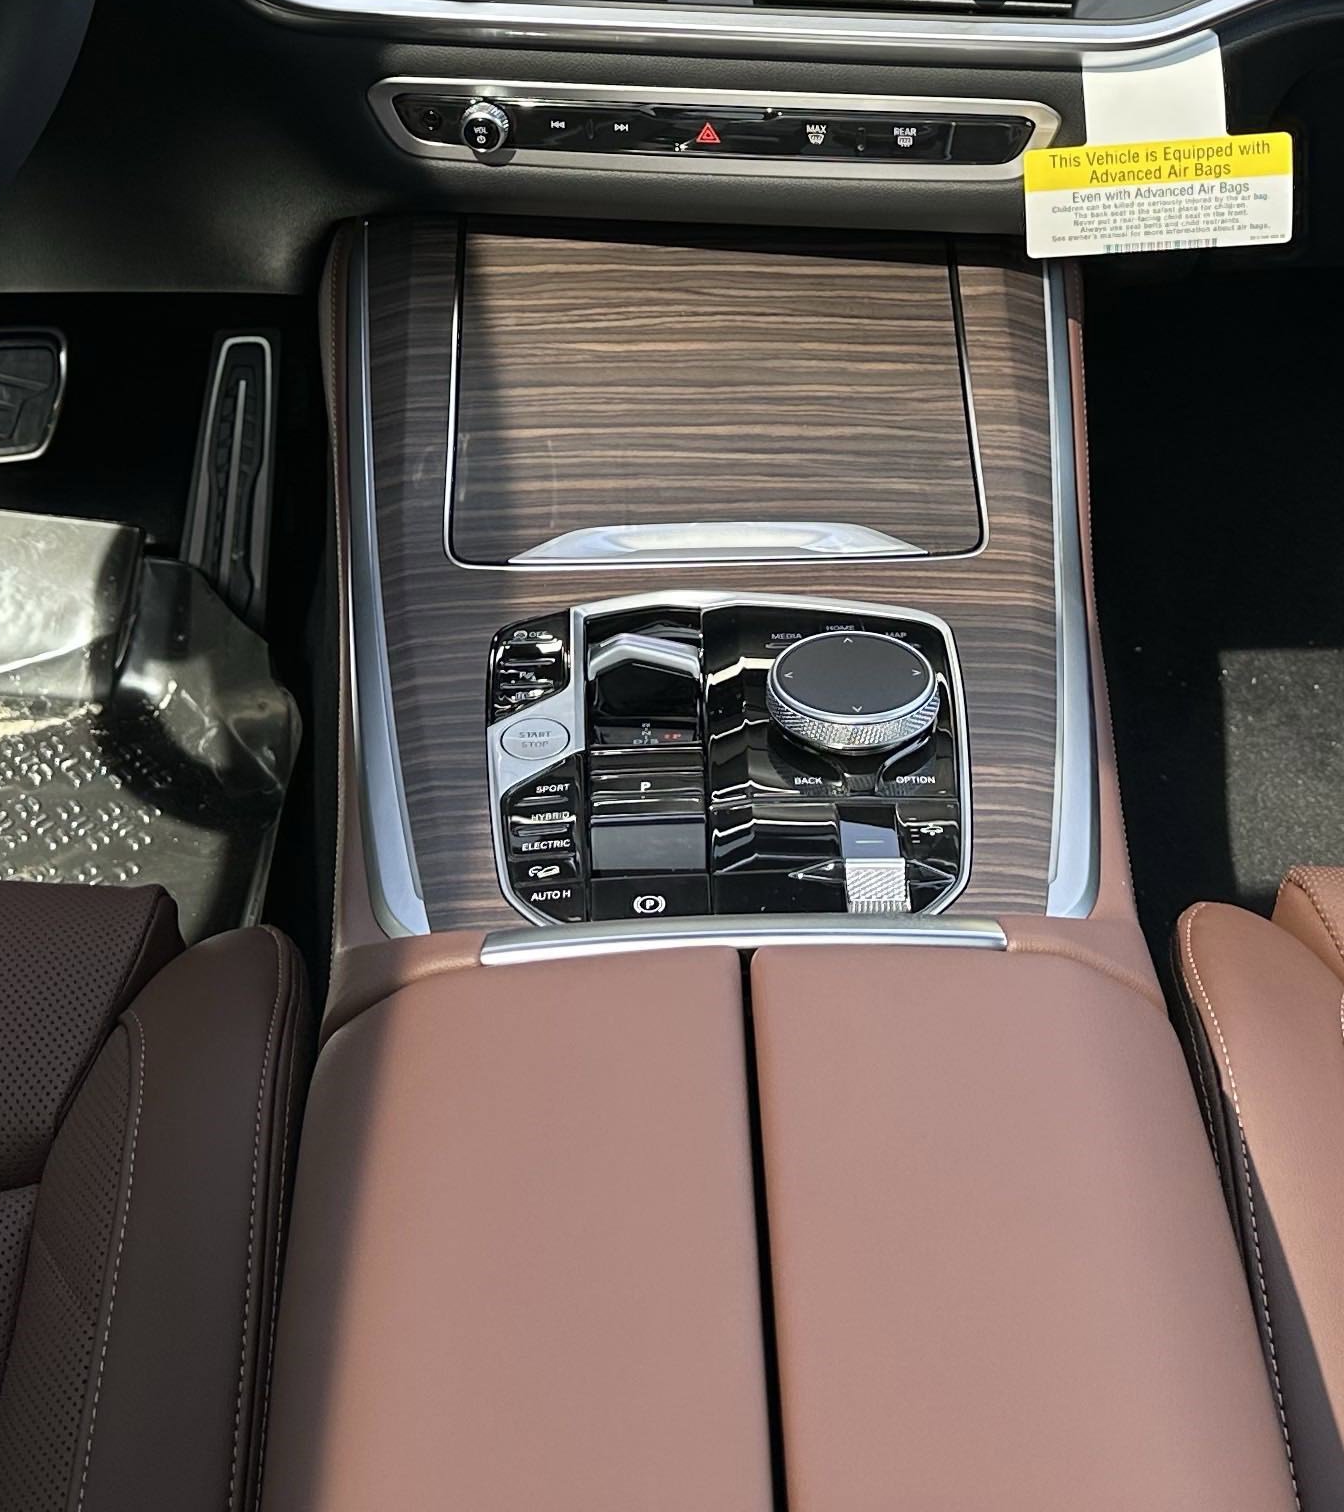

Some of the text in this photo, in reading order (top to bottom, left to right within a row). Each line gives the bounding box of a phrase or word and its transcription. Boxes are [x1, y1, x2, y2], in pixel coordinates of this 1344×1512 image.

[806, 124, 827, 134] MAX
[893, 127, 917, 136] REAR
[1049, 140, 1271, 169] This Vehicle is Equipped with
[1089, 162, 1232, 184] Advanced Air Bags
[1072, 181, 1250, 204] Even with Advanced Air Bags
[771, 632, 802, 640] MEDIA
[519, 730, 552, 739] START
[521, 740, 549, 748] STOP
[794, 776, 823, 785] BACK
[895, 775, 936, 784] OPTION
[535, 783, 571, 794] SPORT
[640, 781, 652, 792] P
[531, 811, 570, 821] HYBRID
[521, 839, 571, 852] ELECTRIC
[530, 889, 571, 901] AUTO H
